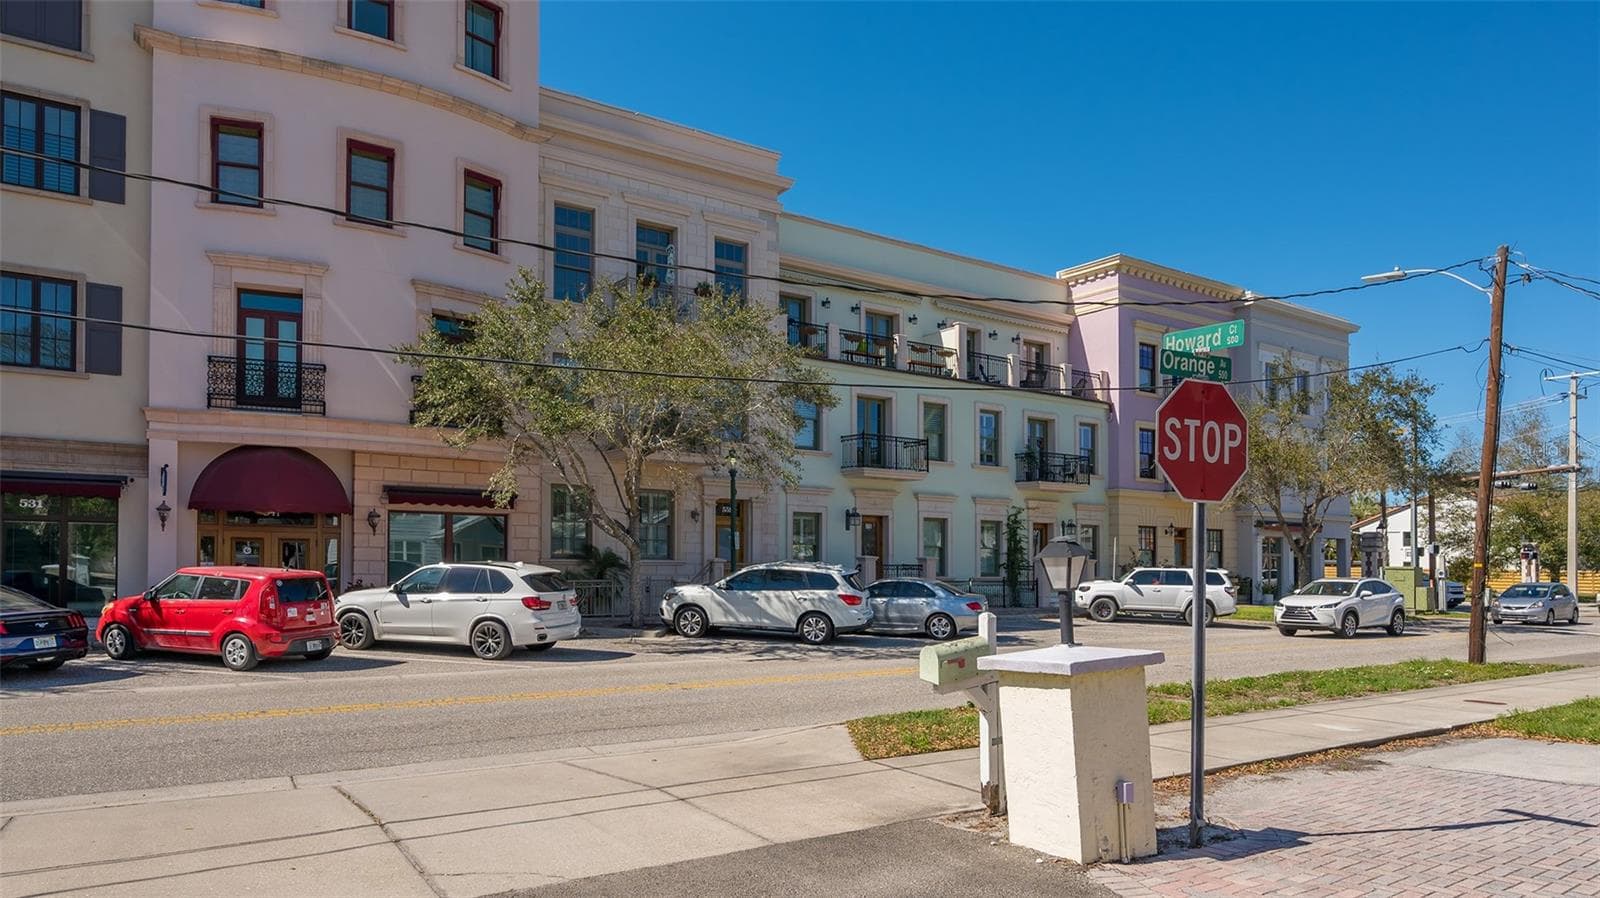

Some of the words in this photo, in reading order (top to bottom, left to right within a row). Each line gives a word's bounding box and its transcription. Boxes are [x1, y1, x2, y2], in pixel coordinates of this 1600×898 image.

[1166, 328, 1221, 351] Howard
[1229, 324, 1237, 334] Ct
[1227, 335, 1239, 345] 500
[1163, 351, 1215, 376] Orange
[1218, 370, 1228, 380] 500
[1163, 417, 1242, 465] STOP
[19, 499, 43, 508] 531
